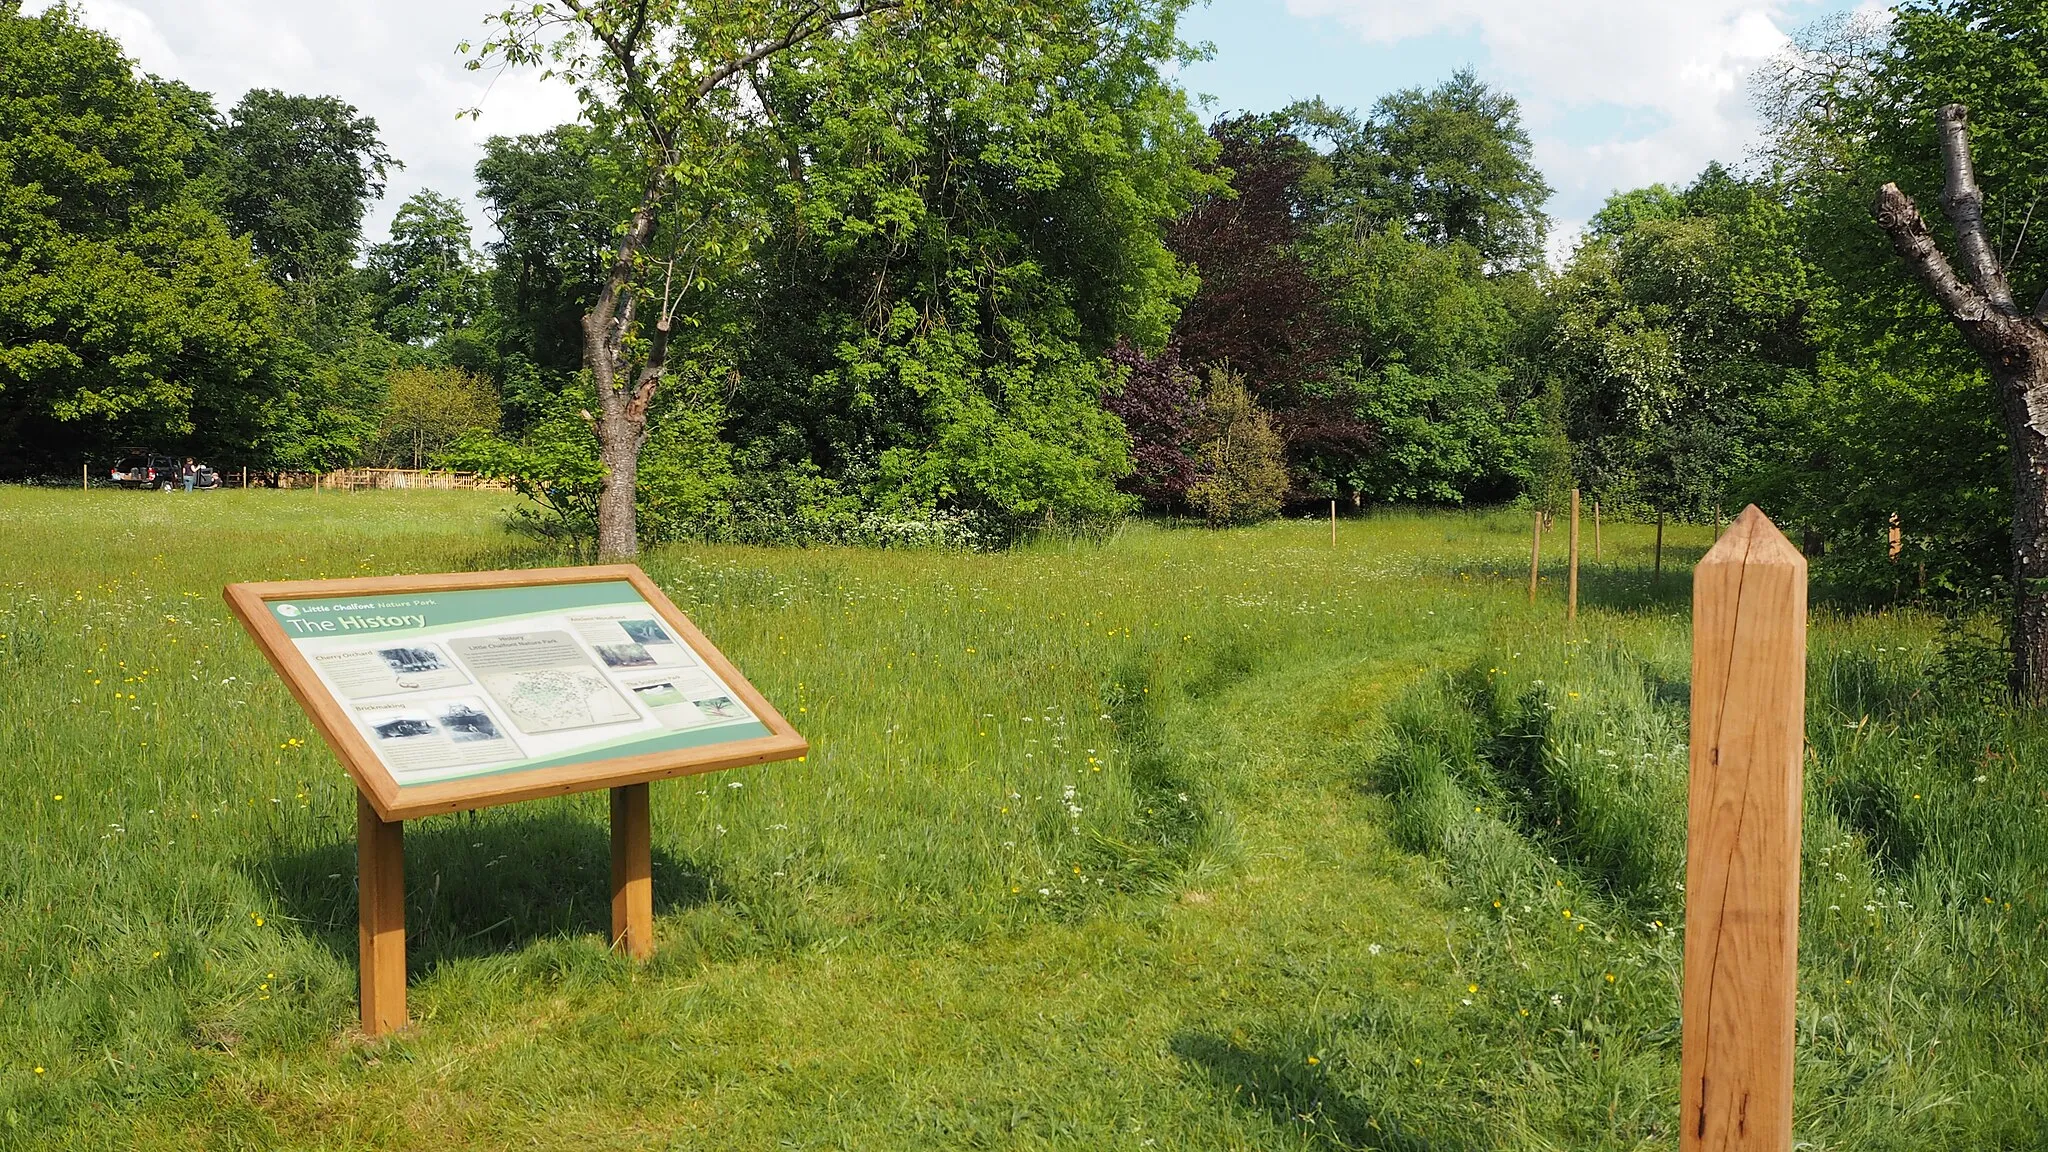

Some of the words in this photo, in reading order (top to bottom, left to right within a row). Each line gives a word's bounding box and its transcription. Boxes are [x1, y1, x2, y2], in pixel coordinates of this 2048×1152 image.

[302, 605, 330, 614] Little
[333, 602, 376, 612] Chalfont
[378, 601, 411, 609] Nature
[286, 618, 336, 633] The
[337, 613, 427, 631] History
[498, 634, 524, 642] History
[468, 643, 487, 651] Little
[487, 641, 518, 650] Chalfont
[315, 653, 342, 662] Cherry
[342, 650, 373, 658] Orchard
[355, 703, 406, 713] Brickmaking
